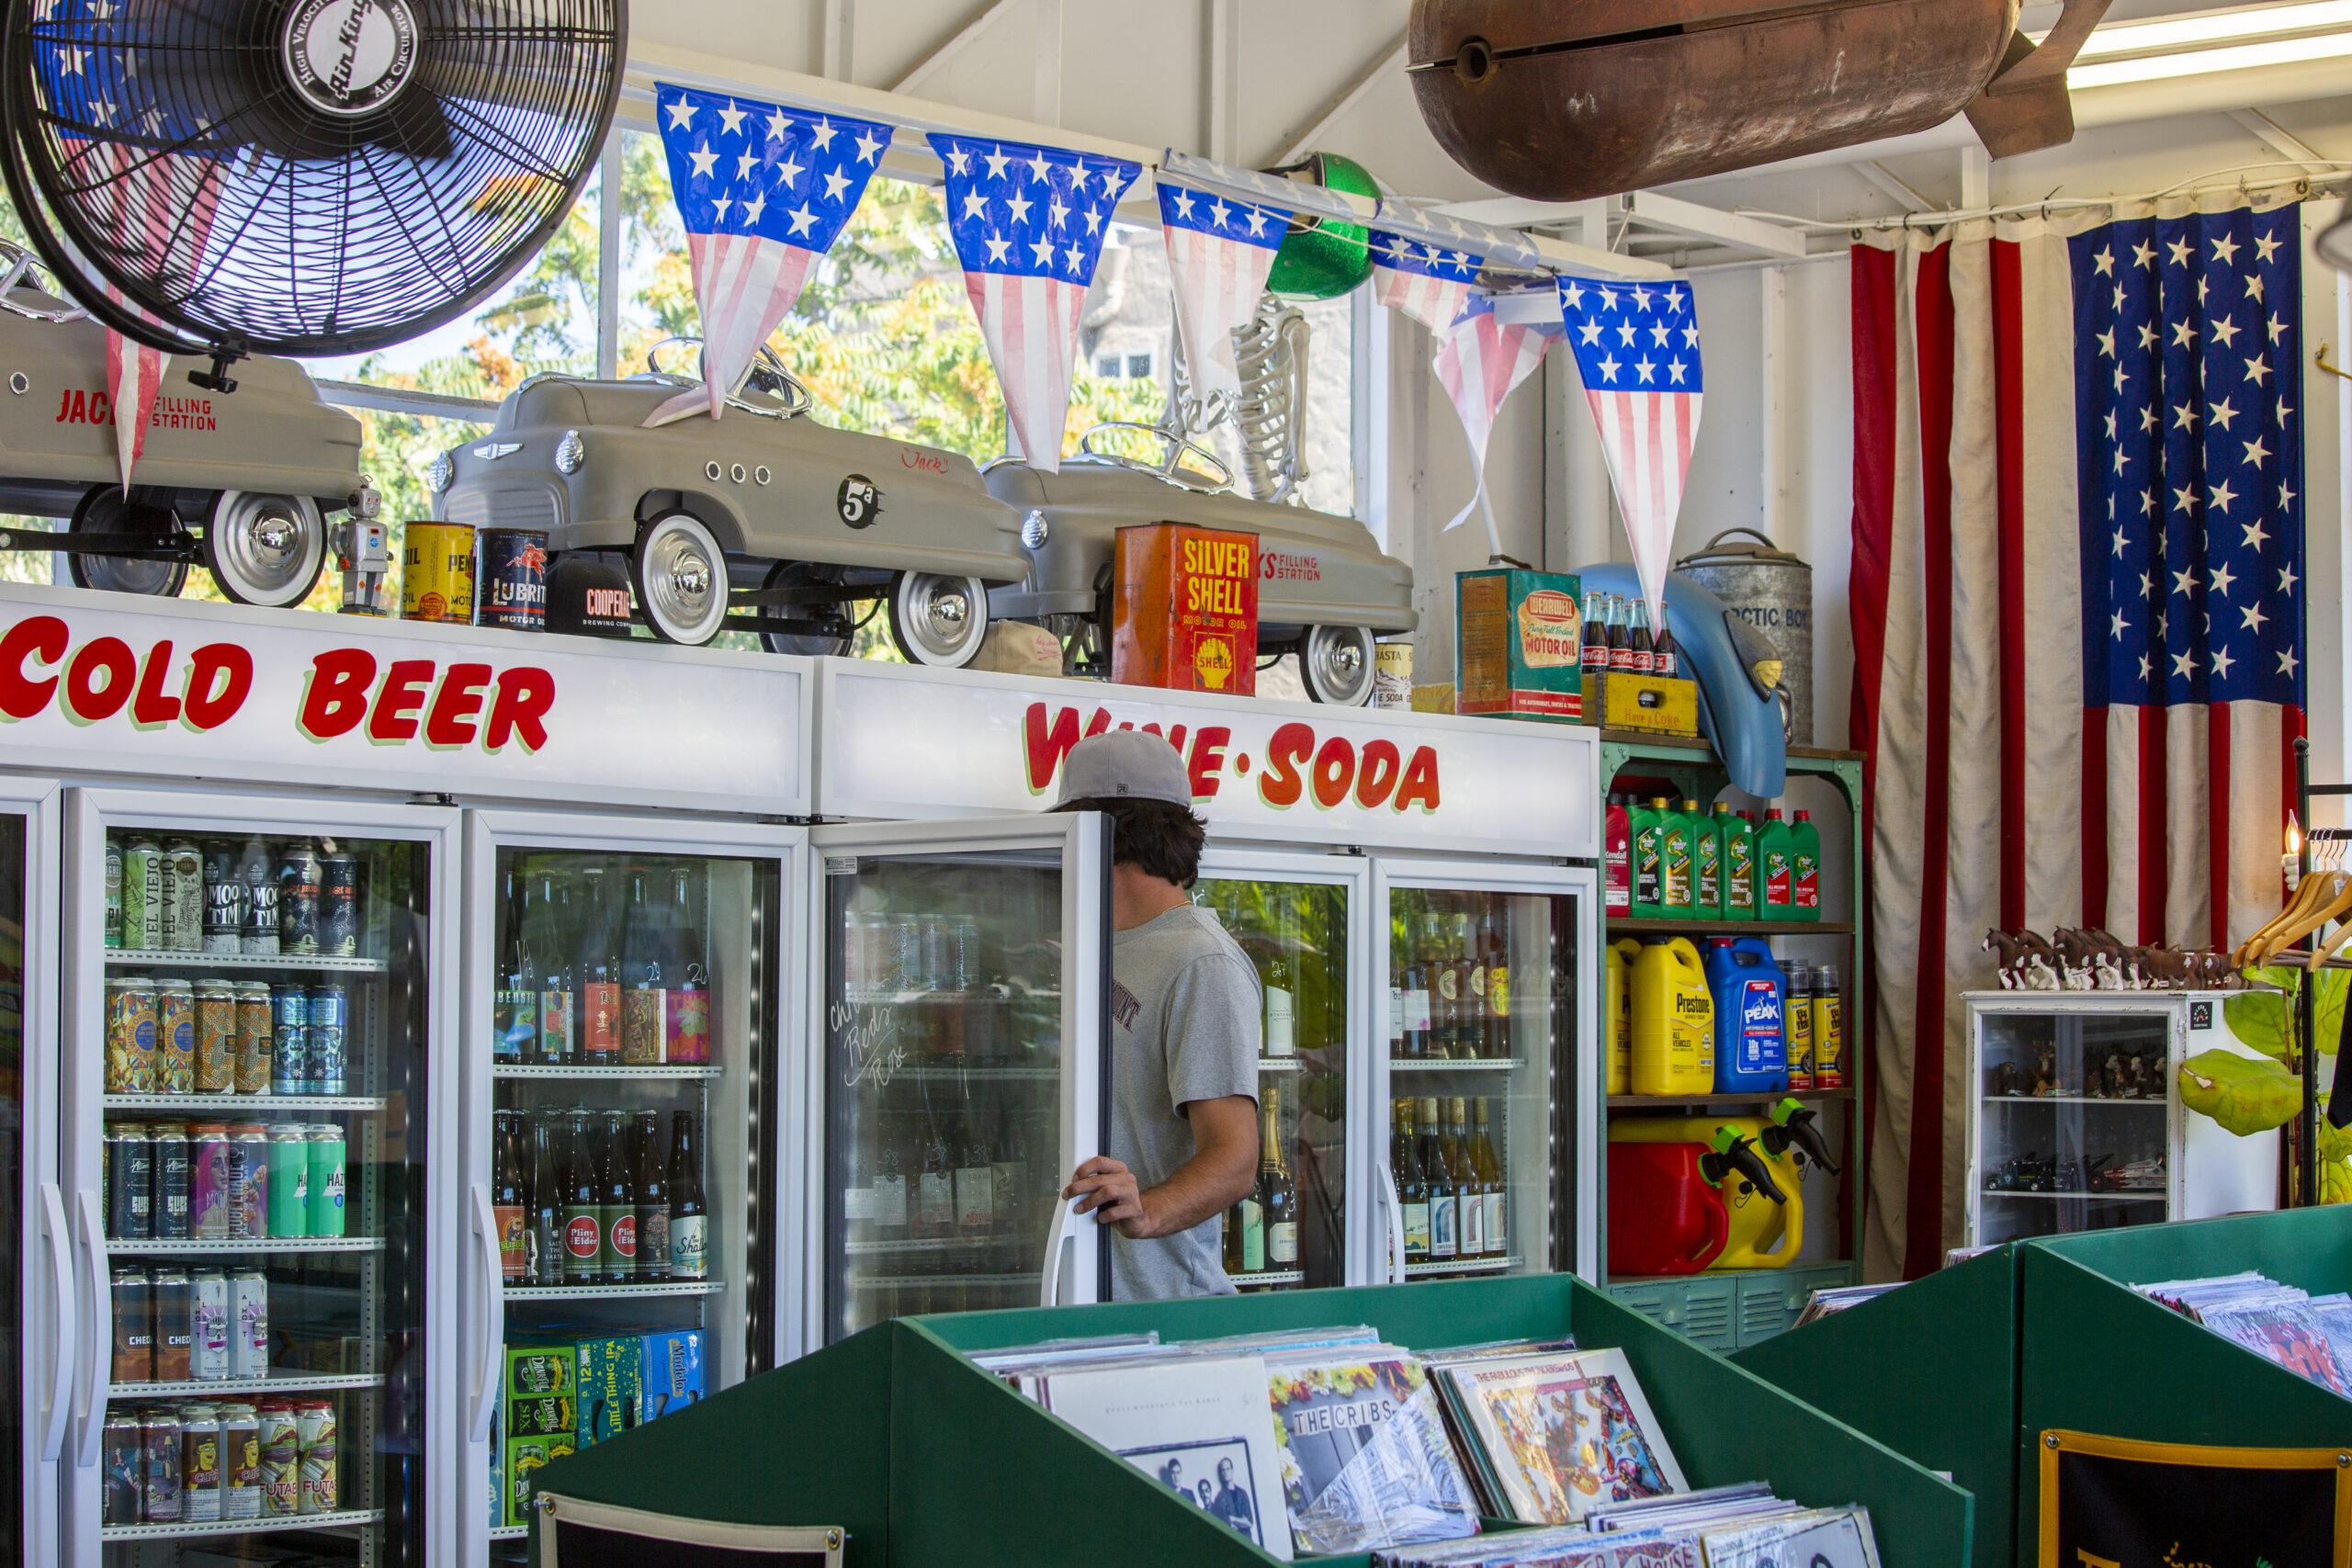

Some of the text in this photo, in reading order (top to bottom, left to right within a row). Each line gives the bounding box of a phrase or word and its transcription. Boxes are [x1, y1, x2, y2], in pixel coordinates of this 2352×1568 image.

[153, 397, 211, 414] FILLING
[153, 413, 216, 431] STATION
[1184, 536, 1250, 579] SILVER
[1279, 554, 1318, 569] FILLING
[1277, 568, 1320, 581] STATION
[1188, 576, 1243, 615] SHELL
[1531, 596, 1573, 618] WEARWELL
[1182, 615, 1247, 630] MOTOR OIL
[1525, 636, 1577, 657] MOTOR OIL
[1199, 657, 1229, 670] SHELL
[0, 616, 556, 754] COLD BEER
[1624, 707, 1645, 721] Have
[1654, 711, 1680, 728] Coke
[1259, 722, 1441, 815] SODA
[1676, 993, 1710, 1013] Prestone
[1745, 1004, 1780, 1024] PEAK
[1672, 1032, 1680, 1040] ALL
[1672, 1040, 1691, 1048] VEHICLES
[571, 1228, 594, 1238] Pliny
[574, 1236, 598, 1246] Elder
[606, 1341, 615, 1359] IPA
[580, 1367, 592, 1383] 12
[673, 1344, 687, 1393] Modelo
[1474, 1373, 1491, 1383] THE
[1295, 1400, 1391, 1434] THE CRIBS
